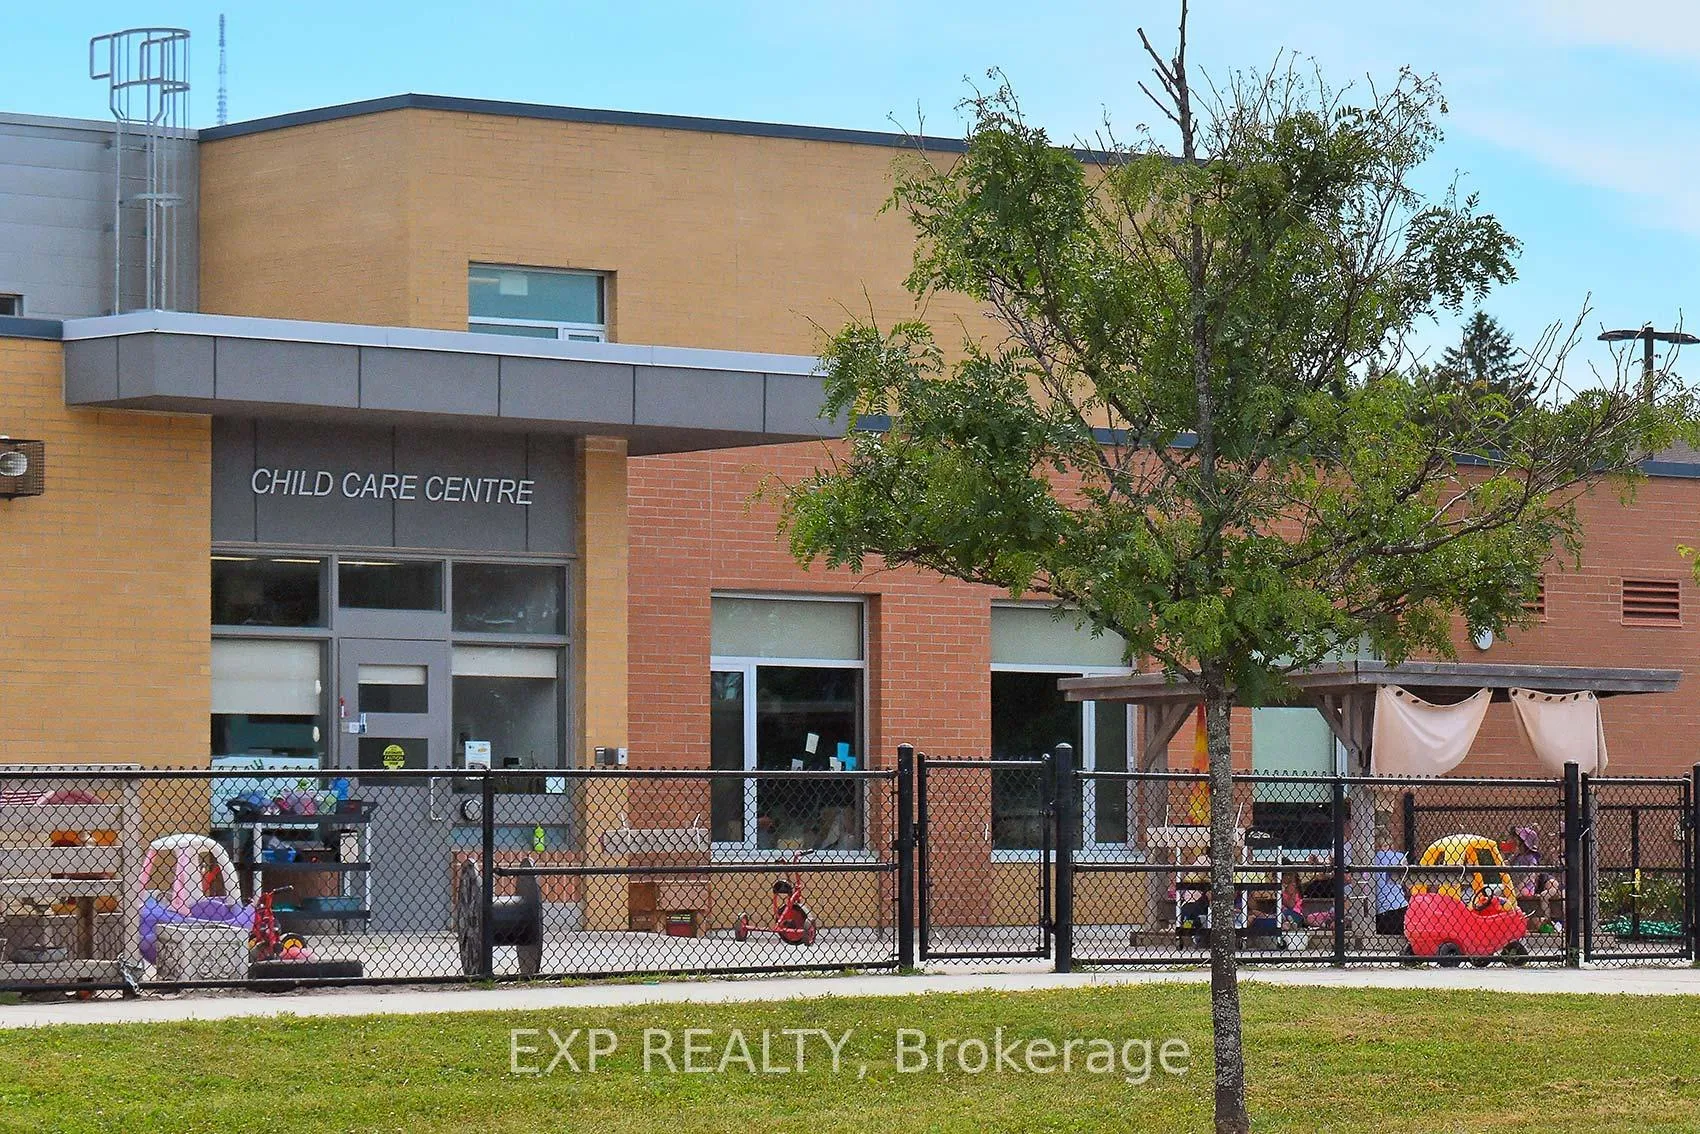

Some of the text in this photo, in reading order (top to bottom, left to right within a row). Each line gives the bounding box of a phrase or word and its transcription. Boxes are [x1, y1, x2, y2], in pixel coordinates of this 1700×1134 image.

[251, 468, 534, 504] CHILD CARE CENTRE
